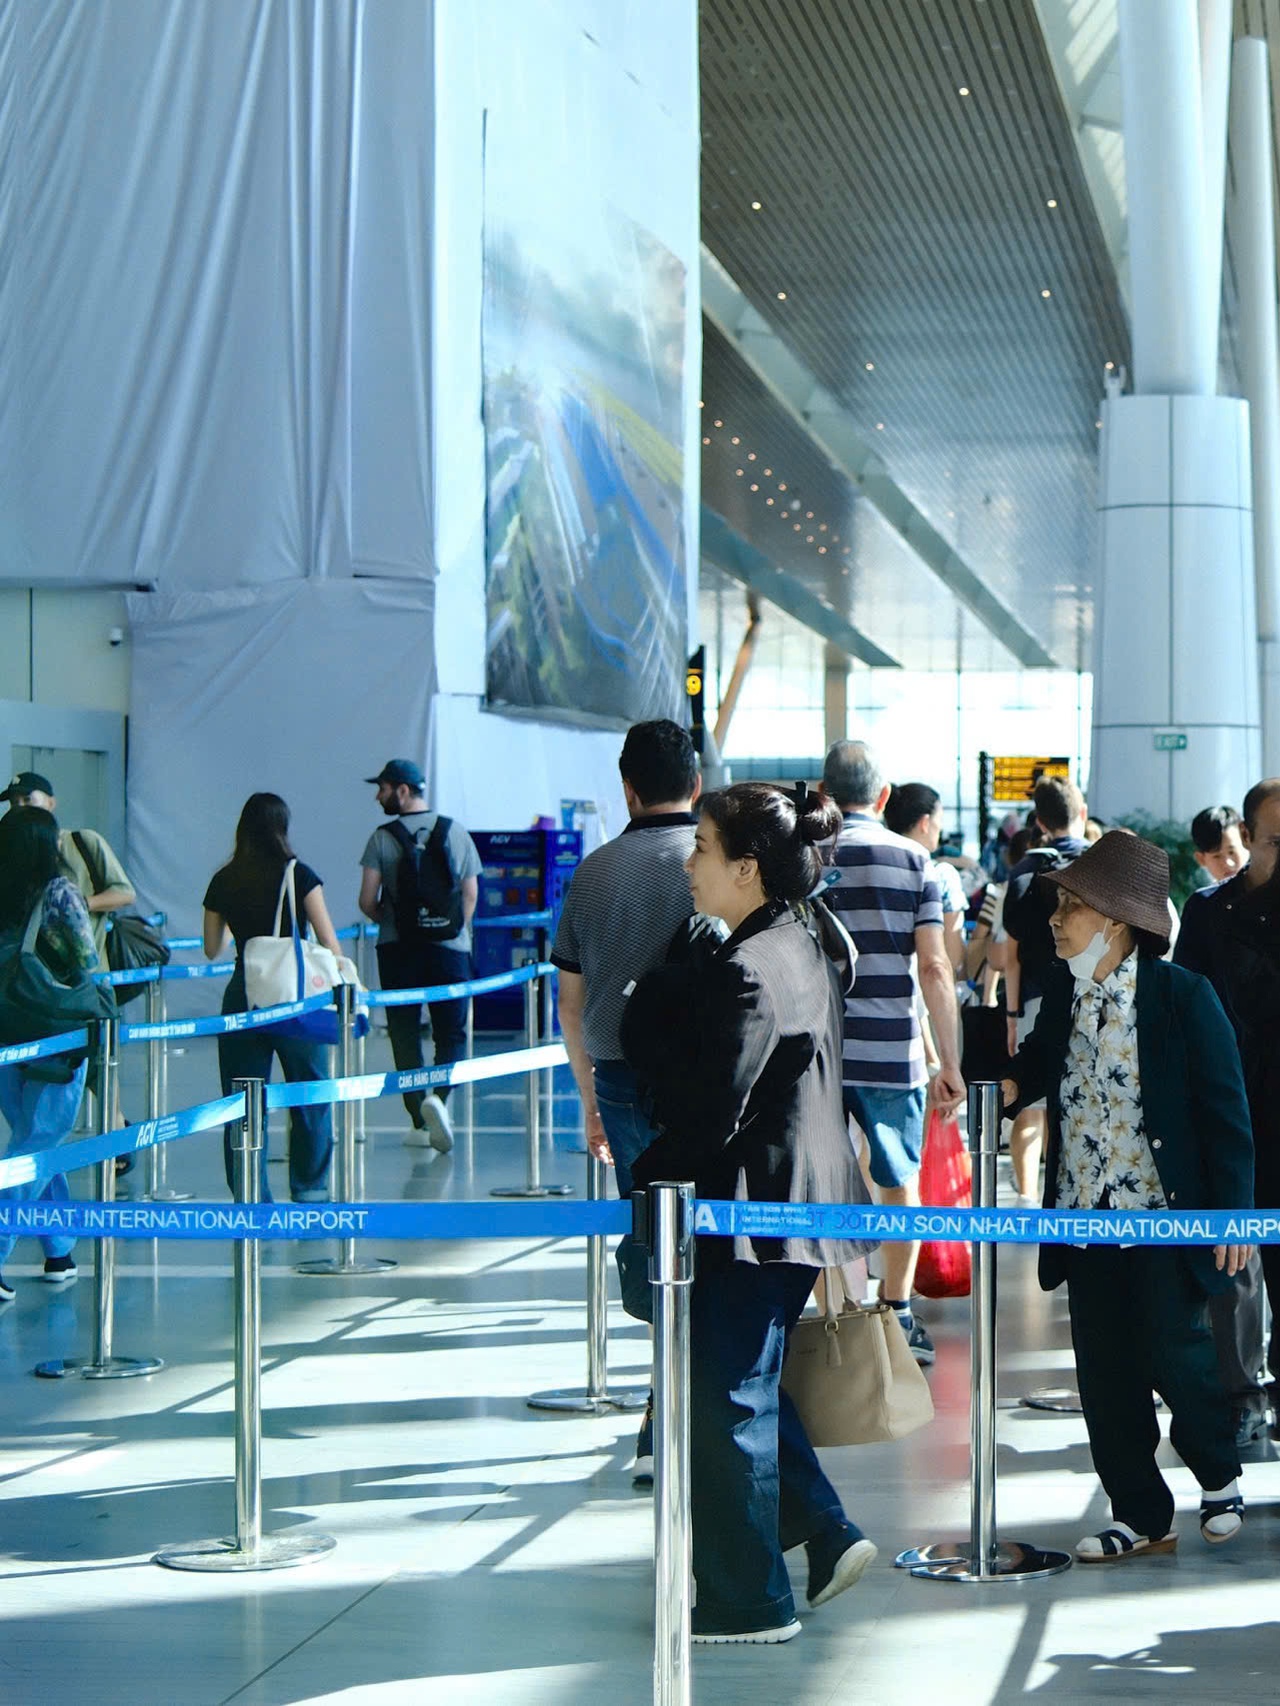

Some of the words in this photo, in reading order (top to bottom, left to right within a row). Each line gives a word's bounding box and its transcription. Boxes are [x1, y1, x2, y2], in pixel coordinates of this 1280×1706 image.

[17, 1208, 77, 1228] NHAT
[84, 1209, 261, 1229] INTERNATIONAL
[267, 1210, 369, 1230] AIRPORT
[862, 1213, 906, 1233] TAN
[913, 1214, 963, 1234] SON
[969, 1216, 1031, 1236] NHAT
[1037, 1217, 1218, 1239] INTERNATIONAL
